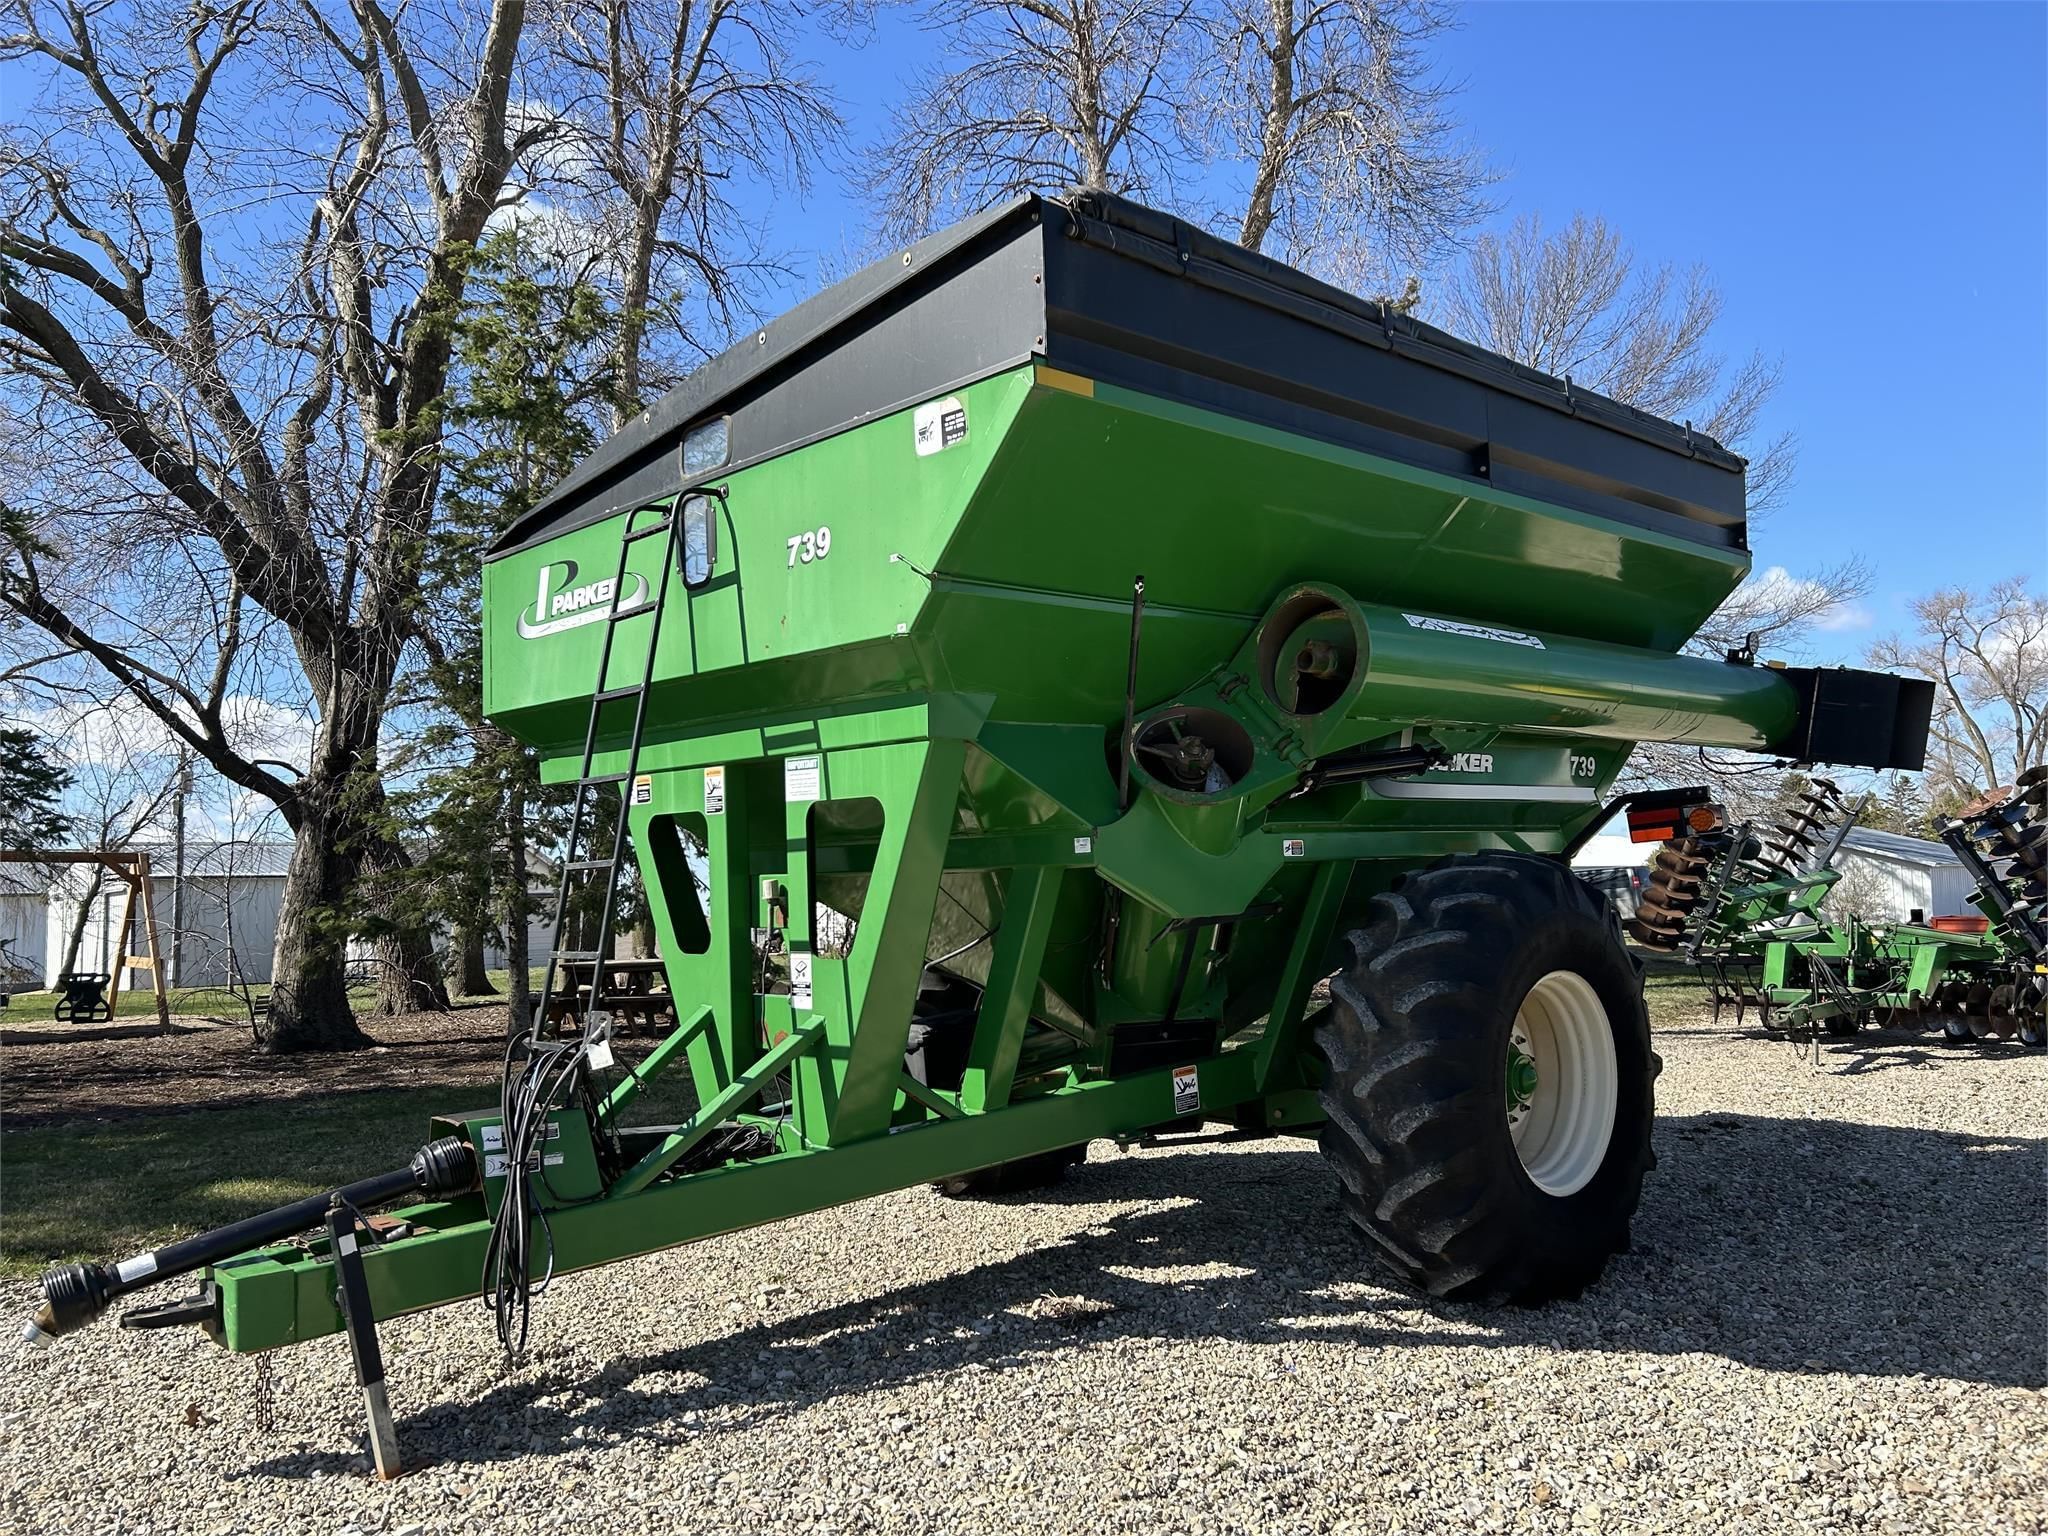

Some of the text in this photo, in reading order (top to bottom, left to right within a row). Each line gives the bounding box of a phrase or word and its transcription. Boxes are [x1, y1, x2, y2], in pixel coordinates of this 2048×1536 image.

[787, 525, 831, 569] 739
[1429, 753, 1494, 773] KER
[1570, 756, 1596, 777] 739
